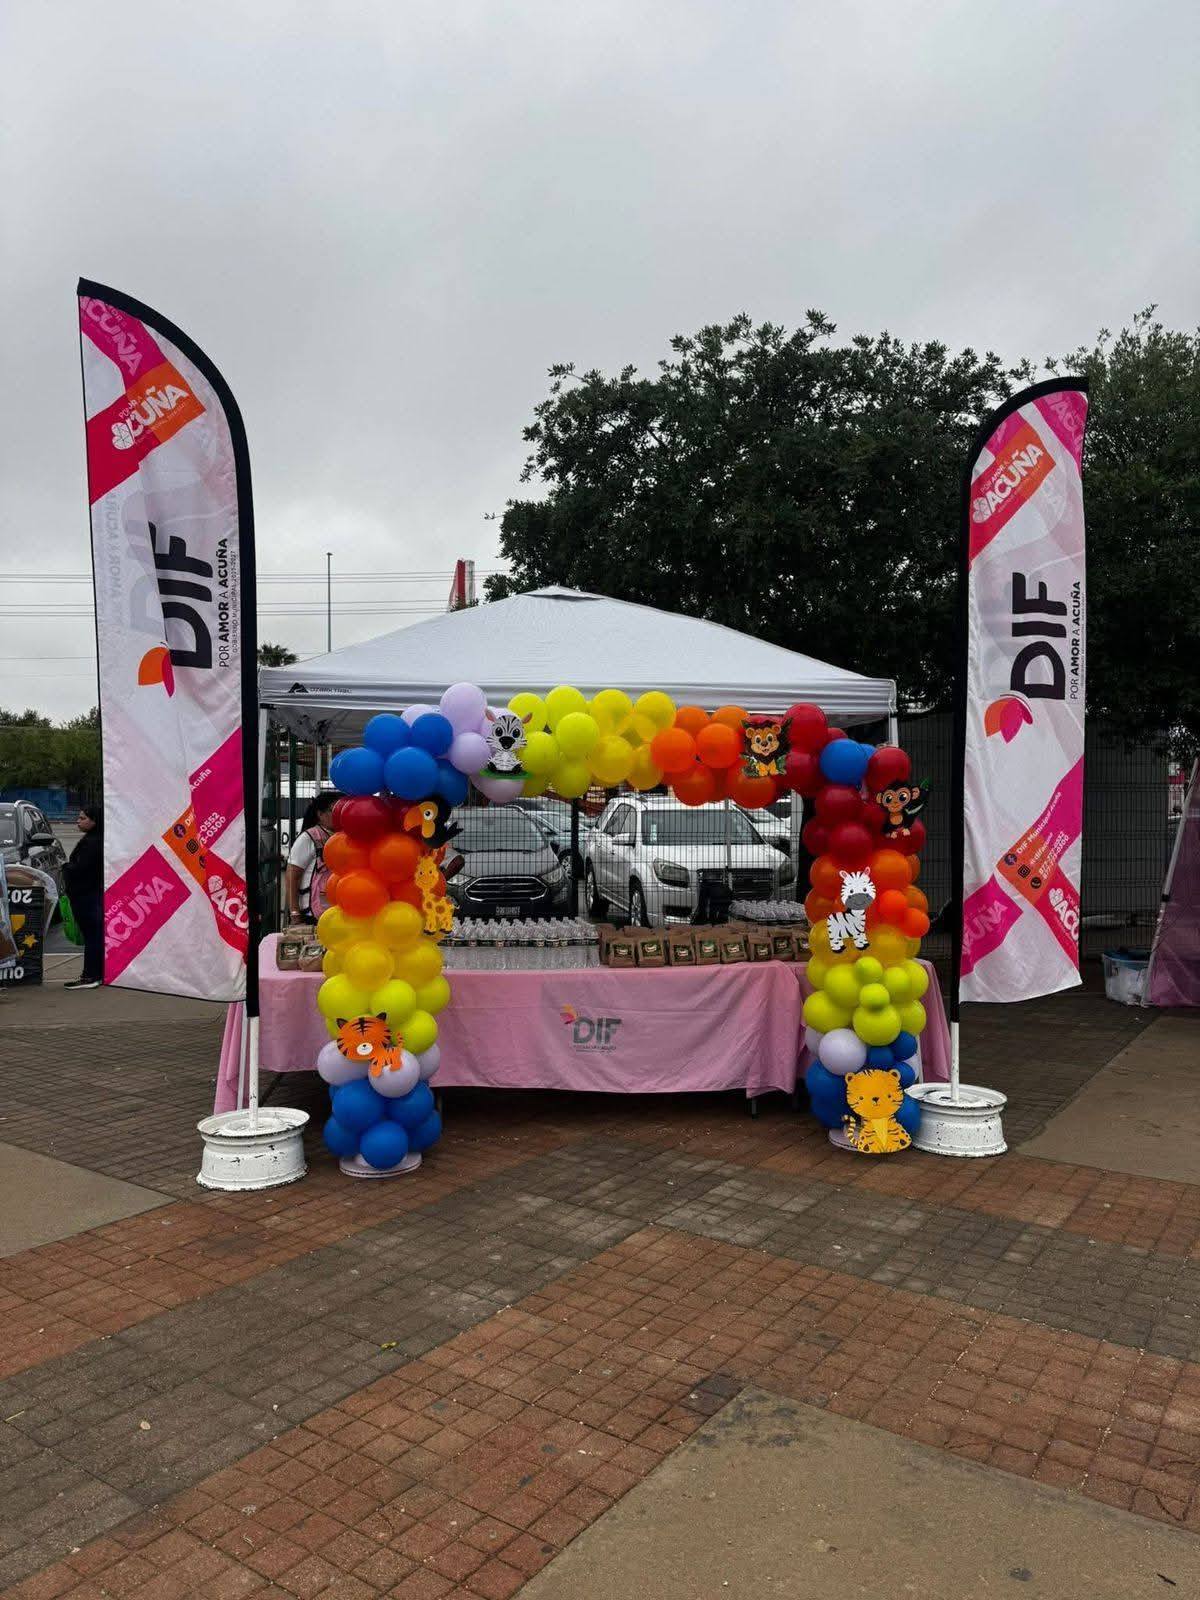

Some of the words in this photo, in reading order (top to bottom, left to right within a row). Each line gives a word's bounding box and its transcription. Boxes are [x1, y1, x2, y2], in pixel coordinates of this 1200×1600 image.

[985, 443, 1044, 515] ACUÑA
[216, 538, 228, 588] ACUÑA
[148, 520, 213, 669] DIF
[219, 590, 229, 599] A
[1070, 581, 1081, 626] ACUÑA
[218, 602, 230, 642] AMOR
[1010, 572, 1067, 700] DIF
[219, 645, 230, 668] POR
[1070, 638, 1080, 676] AMOR
[1070, 679, 1079, 700] POR
[190, 768, 213, 791] Acuña
[199, 812, 220, 834] -0552
[1016, 841, 1028, 854] DIF
[9, 889, 33, 904] 20
[573, 1016, 623, 1044] DIF
